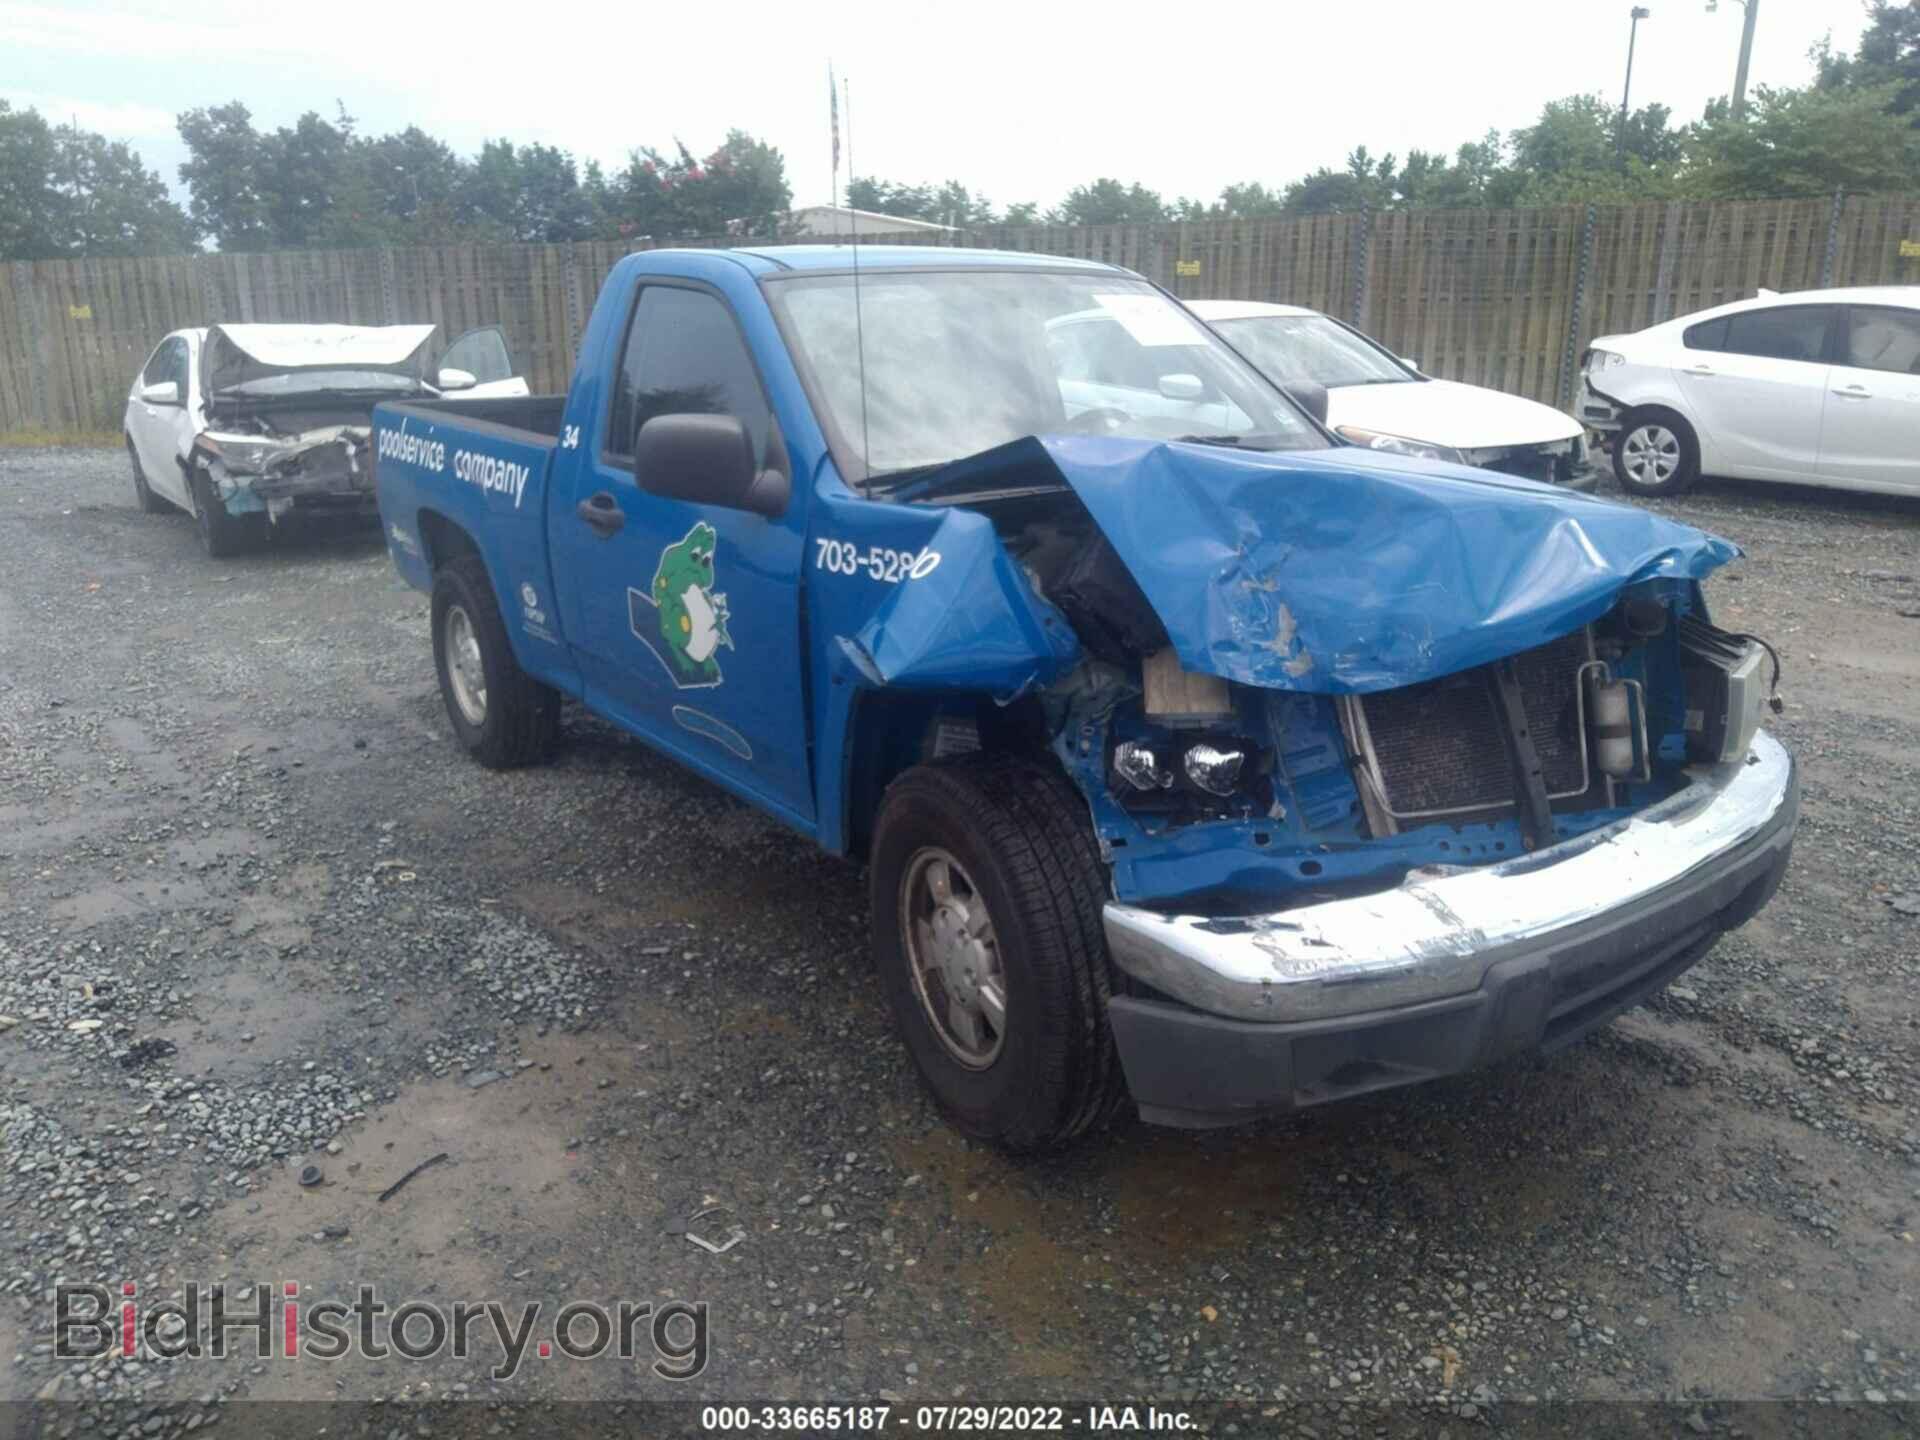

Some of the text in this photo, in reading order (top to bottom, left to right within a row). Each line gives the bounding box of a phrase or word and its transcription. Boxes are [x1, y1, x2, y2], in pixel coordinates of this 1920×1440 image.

[379, 417, 529, 508] poolservice company
[562, 425, 580, 449] 34
